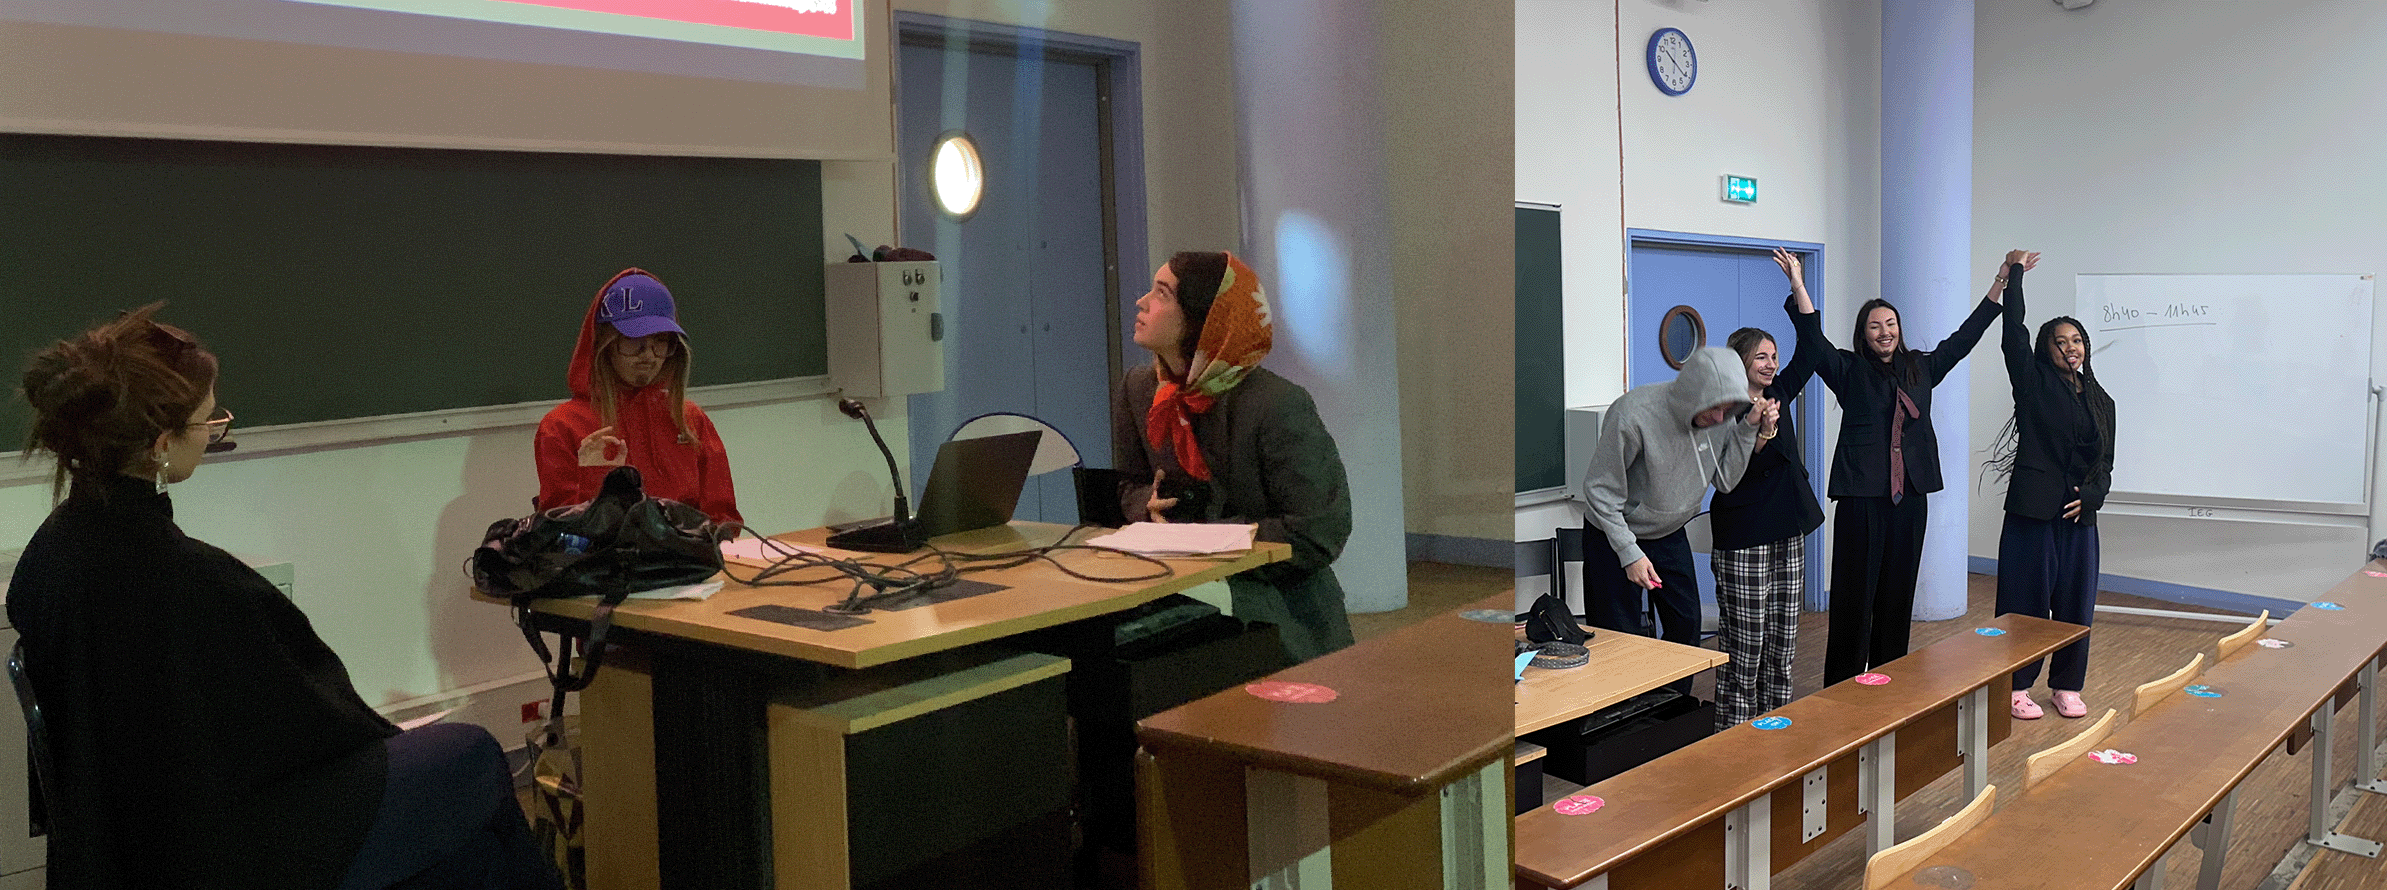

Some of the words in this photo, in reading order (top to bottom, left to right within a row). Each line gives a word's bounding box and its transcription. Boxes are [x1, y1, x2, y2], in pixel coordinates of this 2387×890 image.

[1670, 37, 1676, 45] 12
[1659, 45, 1666, 53] 10
[1657, 55, 1662, 63] 9
[1685, 60, 1690, 68] 3
[1660, 66, 1665, 74] 8
[1665, 74, 1670, 82] 7
[1679, 77, 1684, 85] 5
[1672, 79, 1677, 87] 6
[2103, 302, 2140, 323] 8h40
[2164, 303, 2209, 319] 11h45
